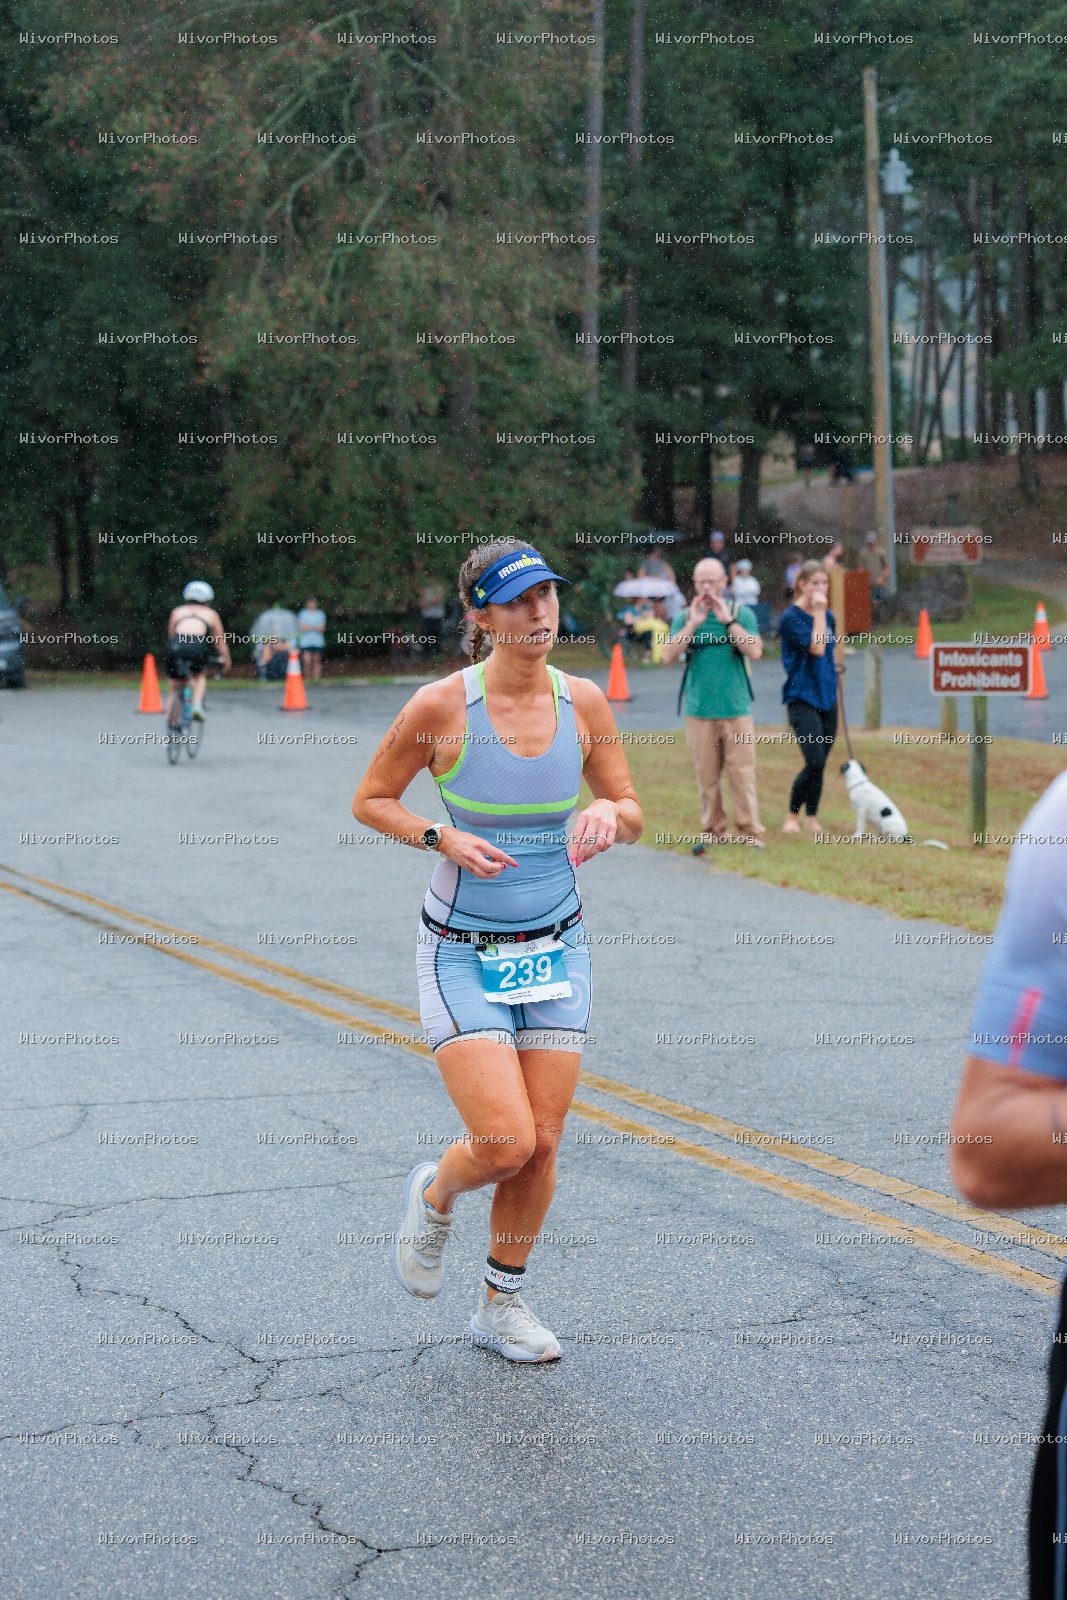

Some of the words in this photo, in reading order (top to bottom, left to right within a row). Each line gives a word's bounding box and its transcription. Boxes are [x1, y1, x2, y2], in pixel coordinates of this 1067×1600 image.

[938, 650, 1023, 668] Intoxicants
[940, 671, 1021, 689] Prohibited
[498, 955, 552, 989] 239
